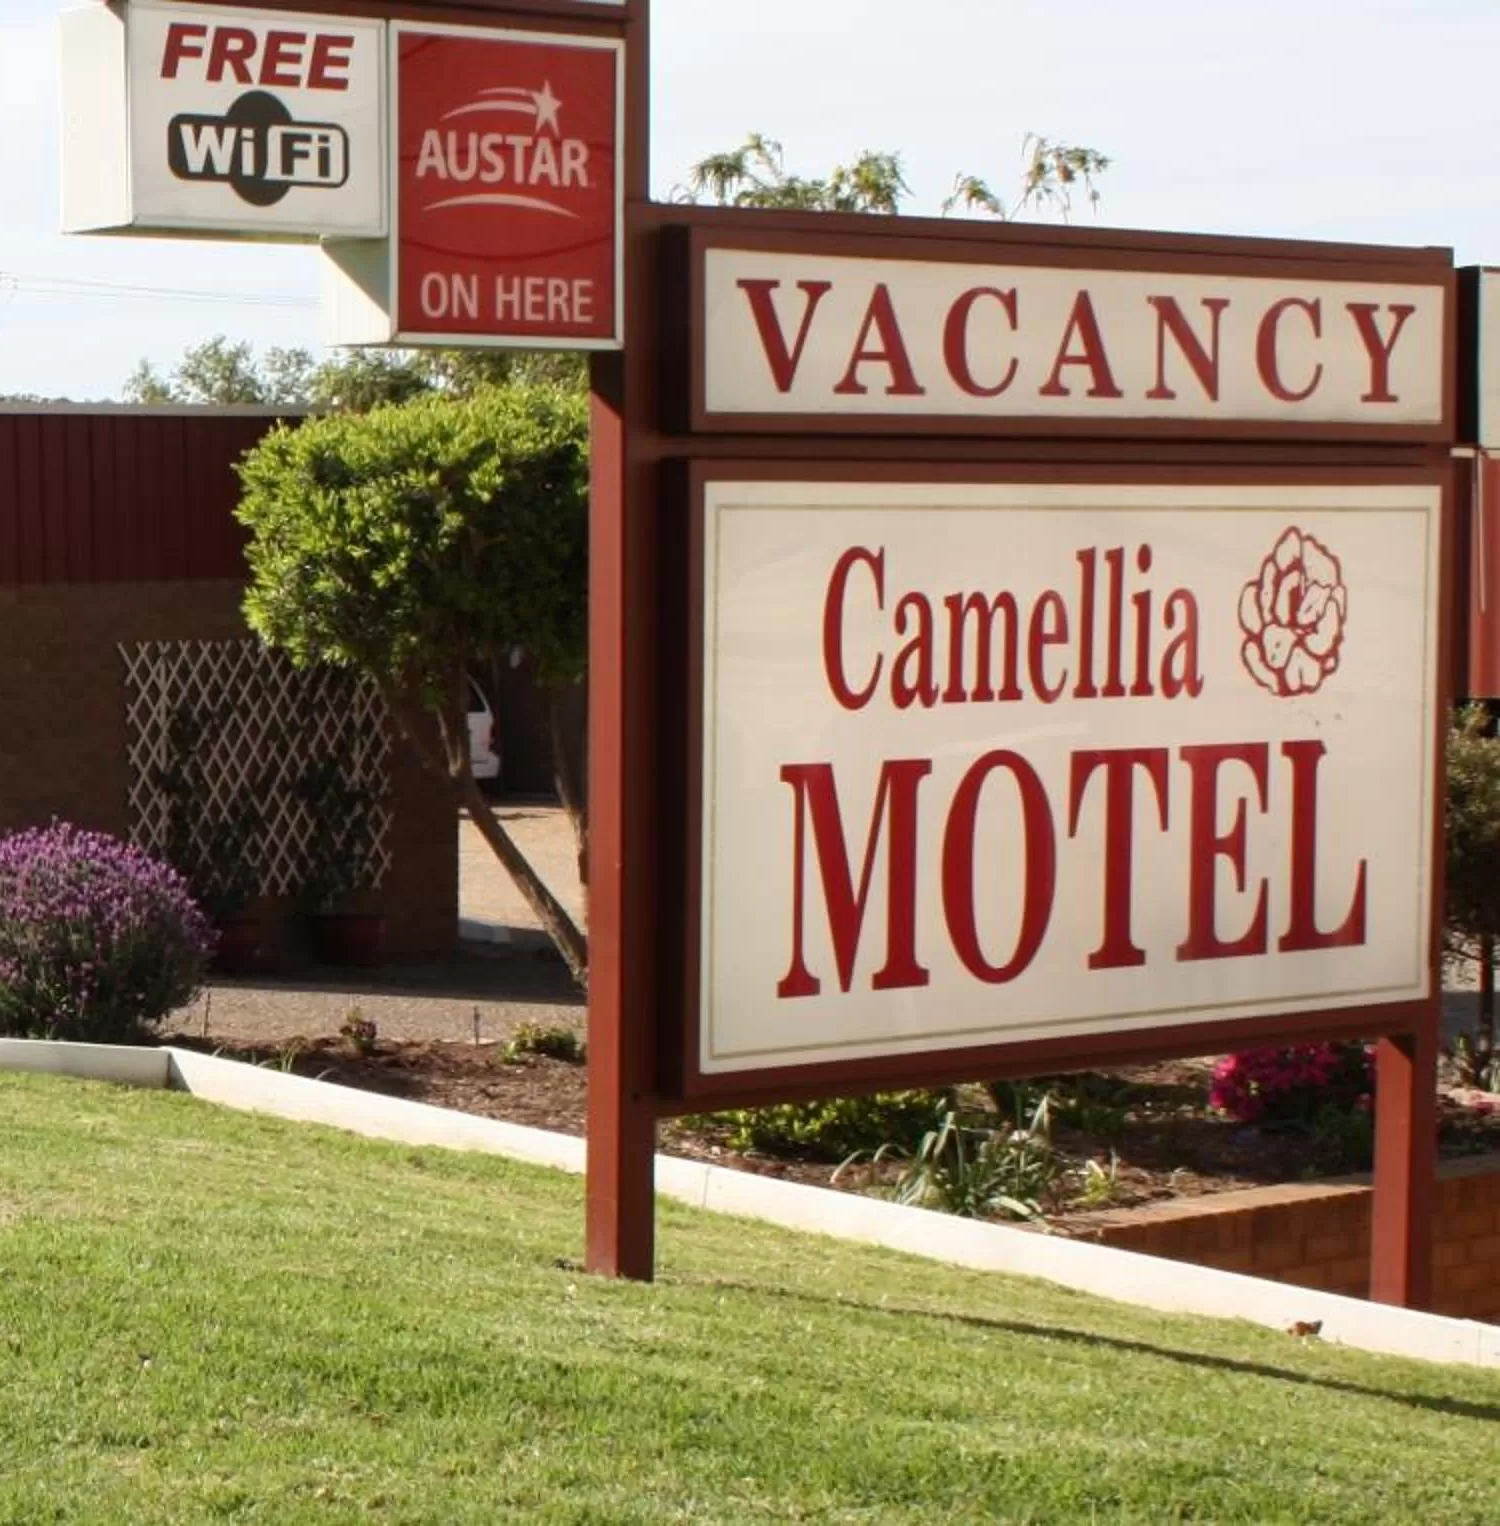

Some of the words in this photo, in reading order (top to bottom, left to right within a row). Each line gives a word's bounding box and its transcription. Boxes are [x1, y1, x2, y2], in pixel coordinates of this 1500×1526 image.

[160, 22, 355, 91] FREE
[415, 128, 590, 188] AUSTAR
[420, 271, 479, 320] ON
[495, 275, 594, 324] HERE
[736, 278, 1416, 403] VACANCY
[823, 542, 1205, 711] Camellia
[776, 739, 1368, 999] MOTEL
